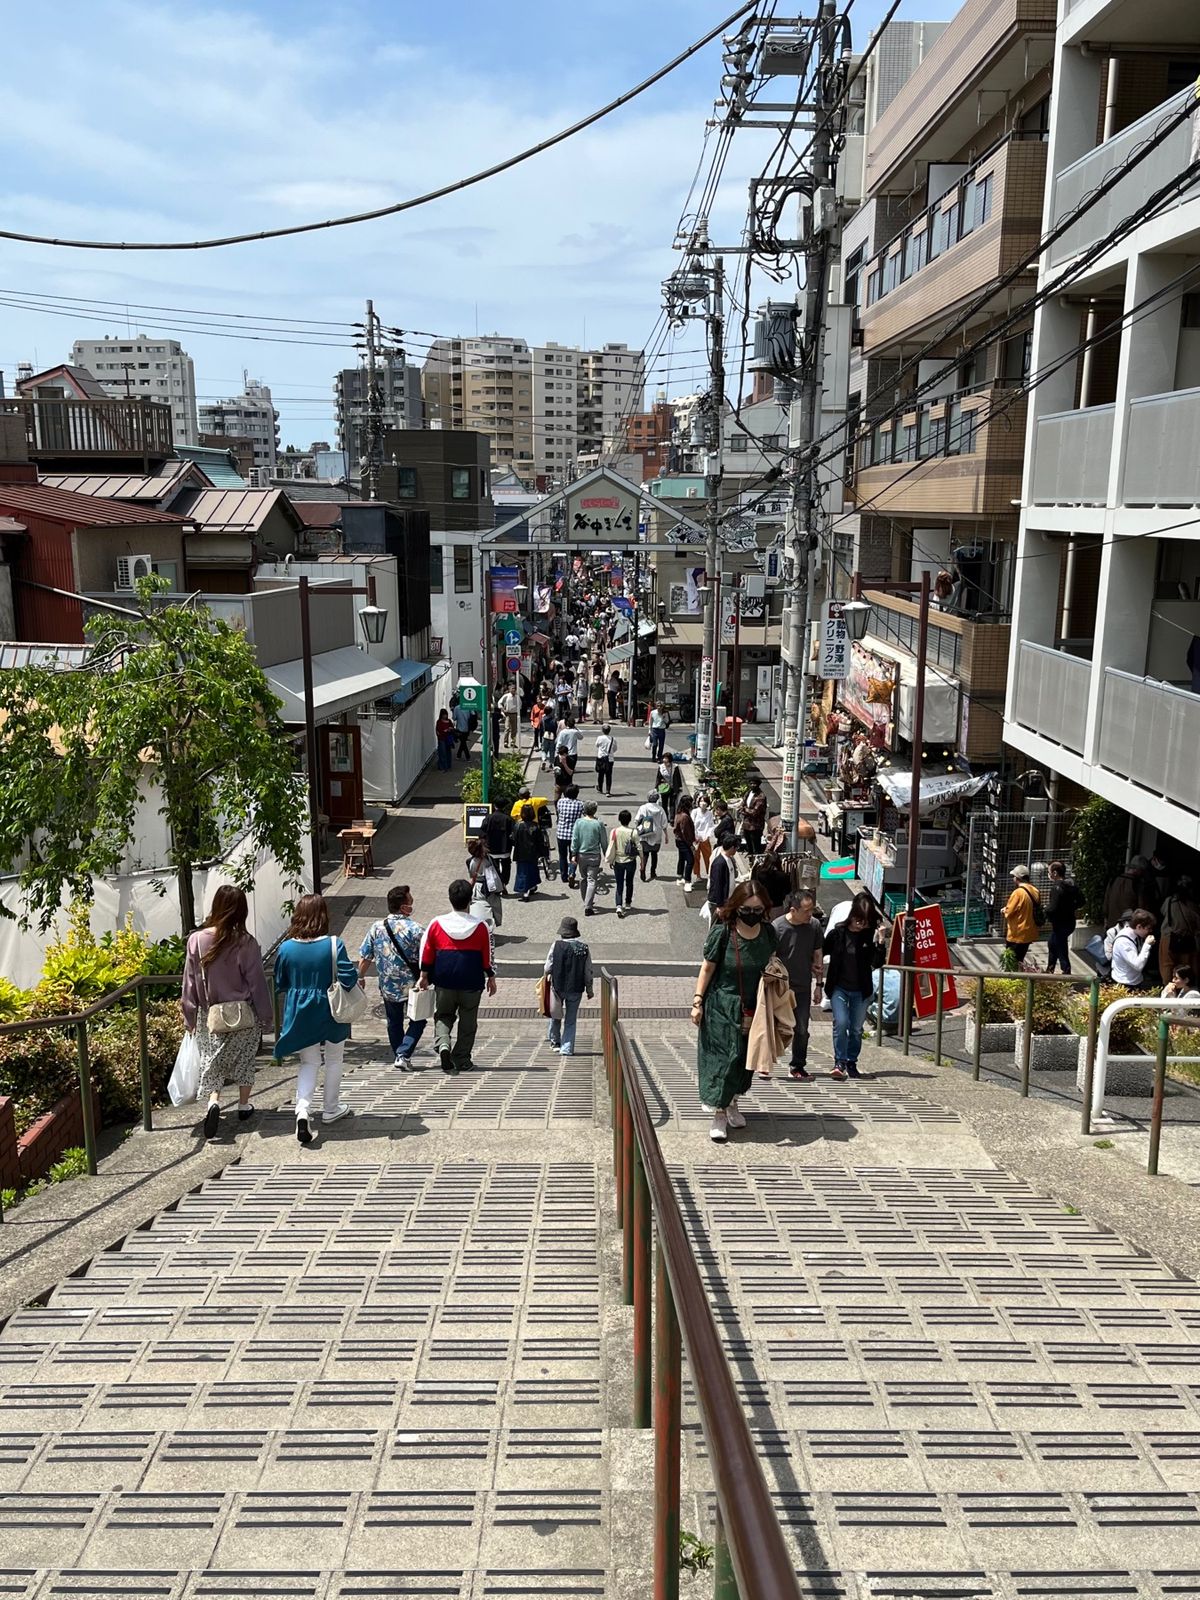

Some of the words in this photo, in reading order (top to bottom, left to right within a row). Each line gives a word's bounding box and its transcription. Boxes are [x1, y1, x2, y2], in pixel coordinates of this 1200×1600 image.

[573, 505, 633, 536] 谷中ぎんざ
[825, 620, 835, 663] クリニック
